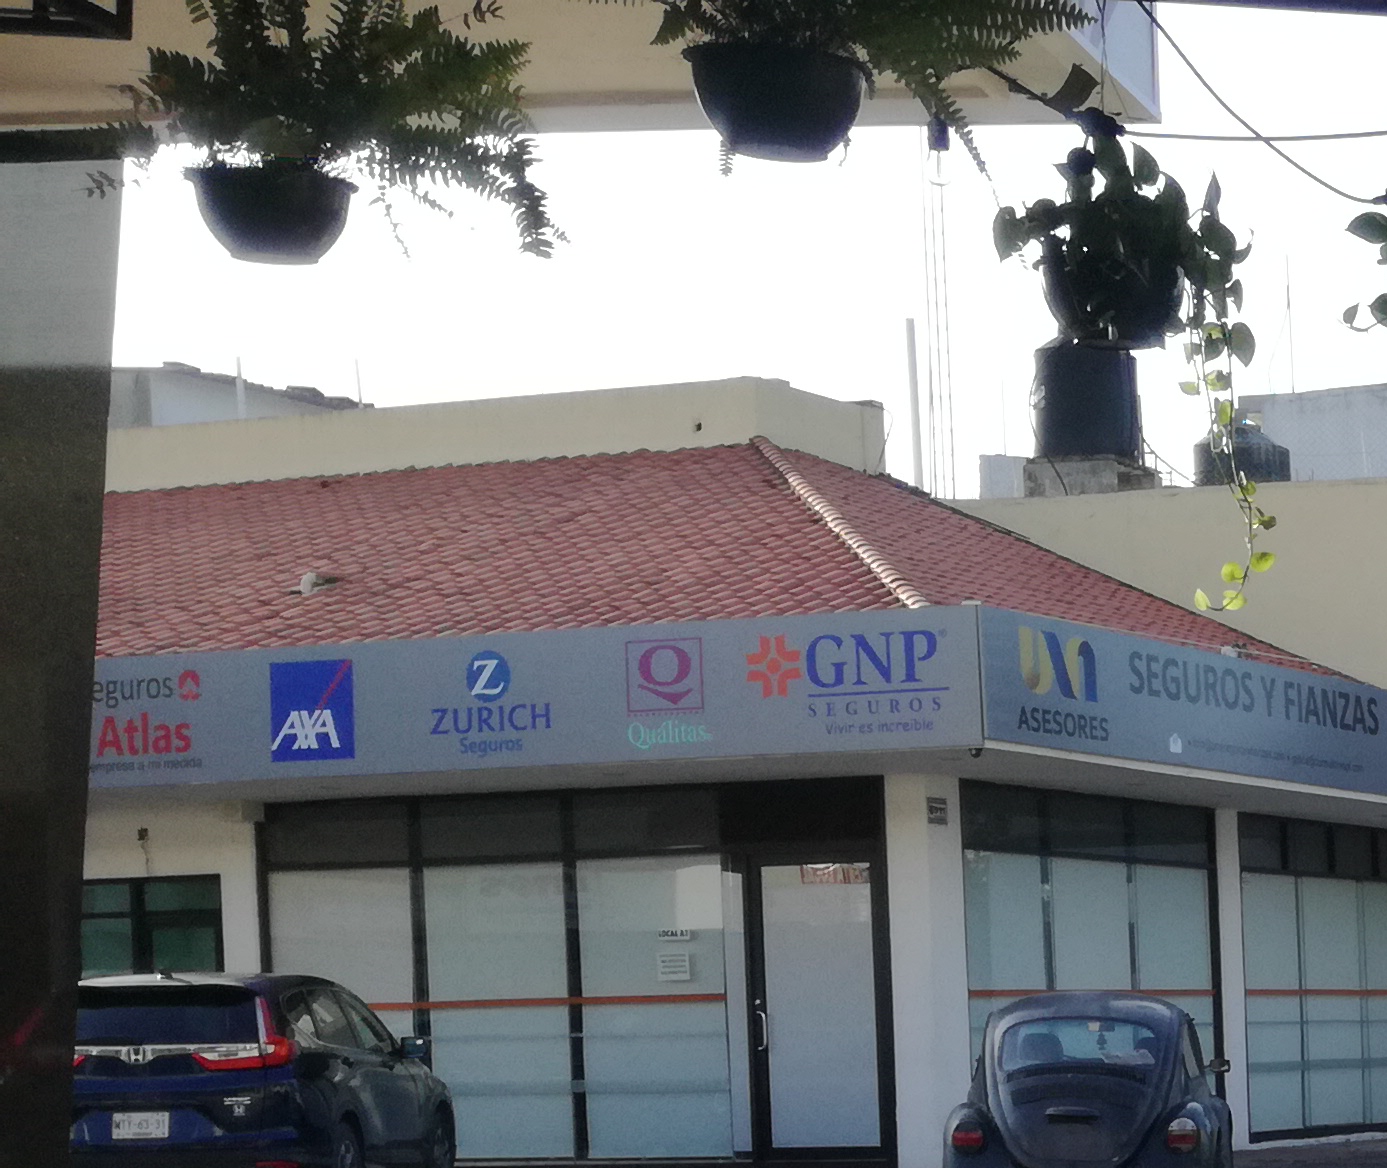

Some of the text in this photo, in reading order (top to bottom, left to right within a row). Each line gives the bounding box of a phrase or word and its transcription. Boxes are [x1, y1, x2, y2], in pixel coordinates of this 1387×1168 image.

[806, 629, 938, 689] GNP
[92, 677, 174, 709] eguros
[807, 697, 942, 718] SEGUROS
[1128, 651, 1380, 736] SEGUROS Y FIANZAS
[96, 711, 192, 758] Atlas
[271, 709, 341, 751] AXA
[430, 703, 552, 735] ZURICH
[858, 722, 873, 733] es
[1017, 706, 1110, 741] ASESORES
[460, 737, 523, 758] Seguros
